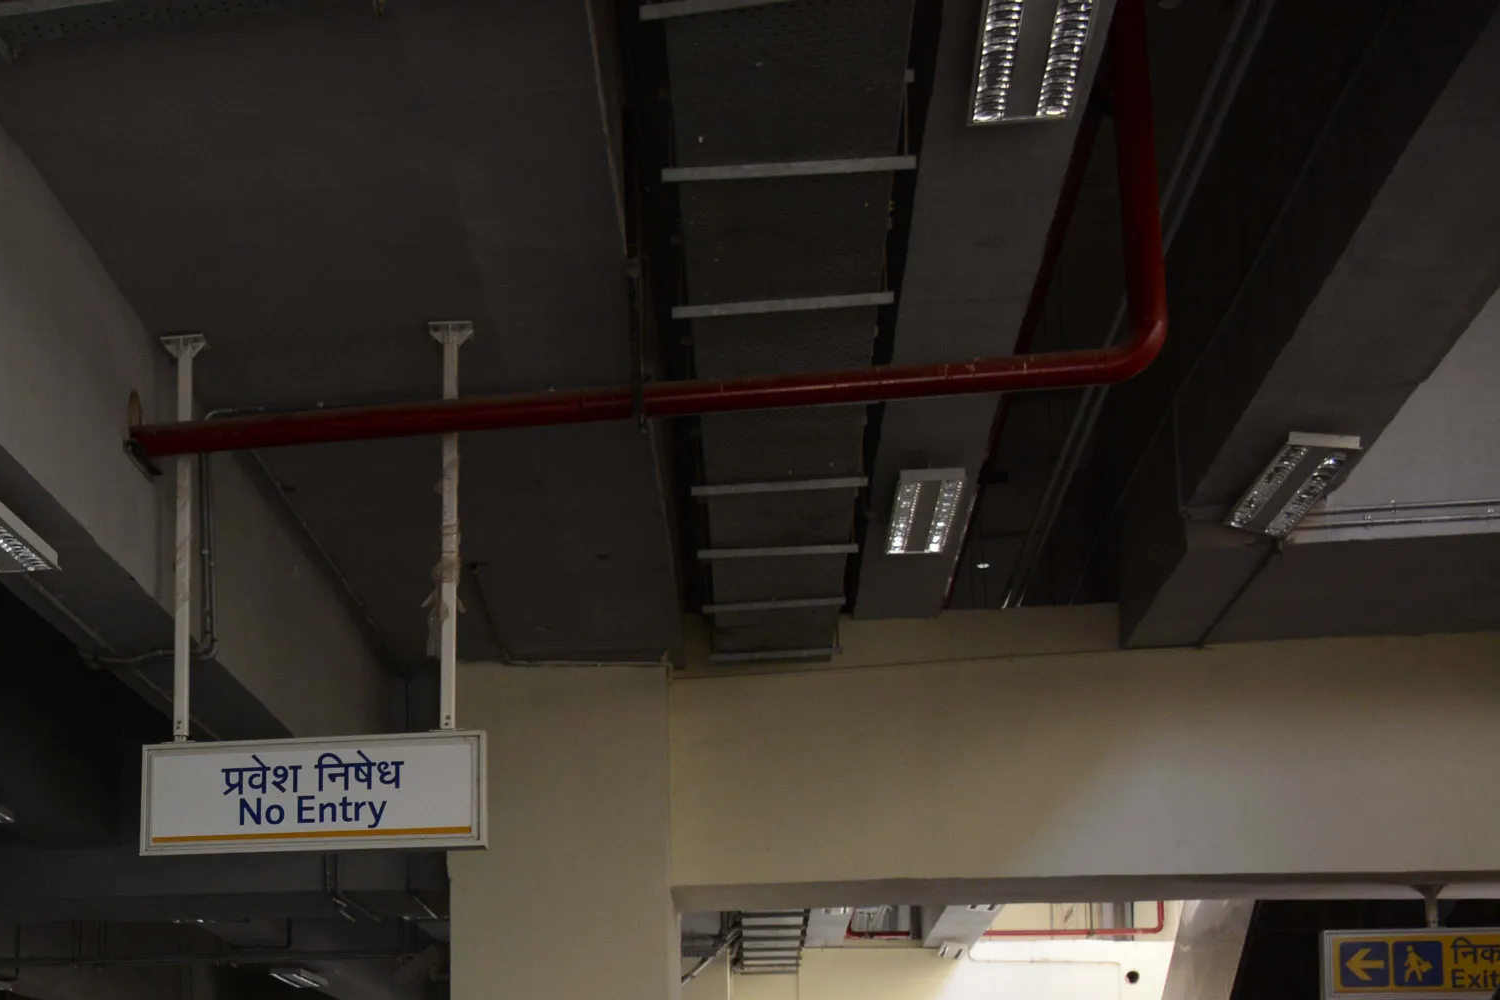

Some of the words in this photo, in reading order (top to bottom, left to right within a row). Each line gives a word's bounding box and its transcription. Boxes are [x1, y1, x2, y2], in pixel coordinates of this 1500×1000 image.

[221, 754, 302, 796] प्रवेश
[314, 749, 405, 792] निषेध
[239, 797, 285, 826] No
[297, 794, 388, 829] Entry
[1451, 968, 1500, 988] Exit
